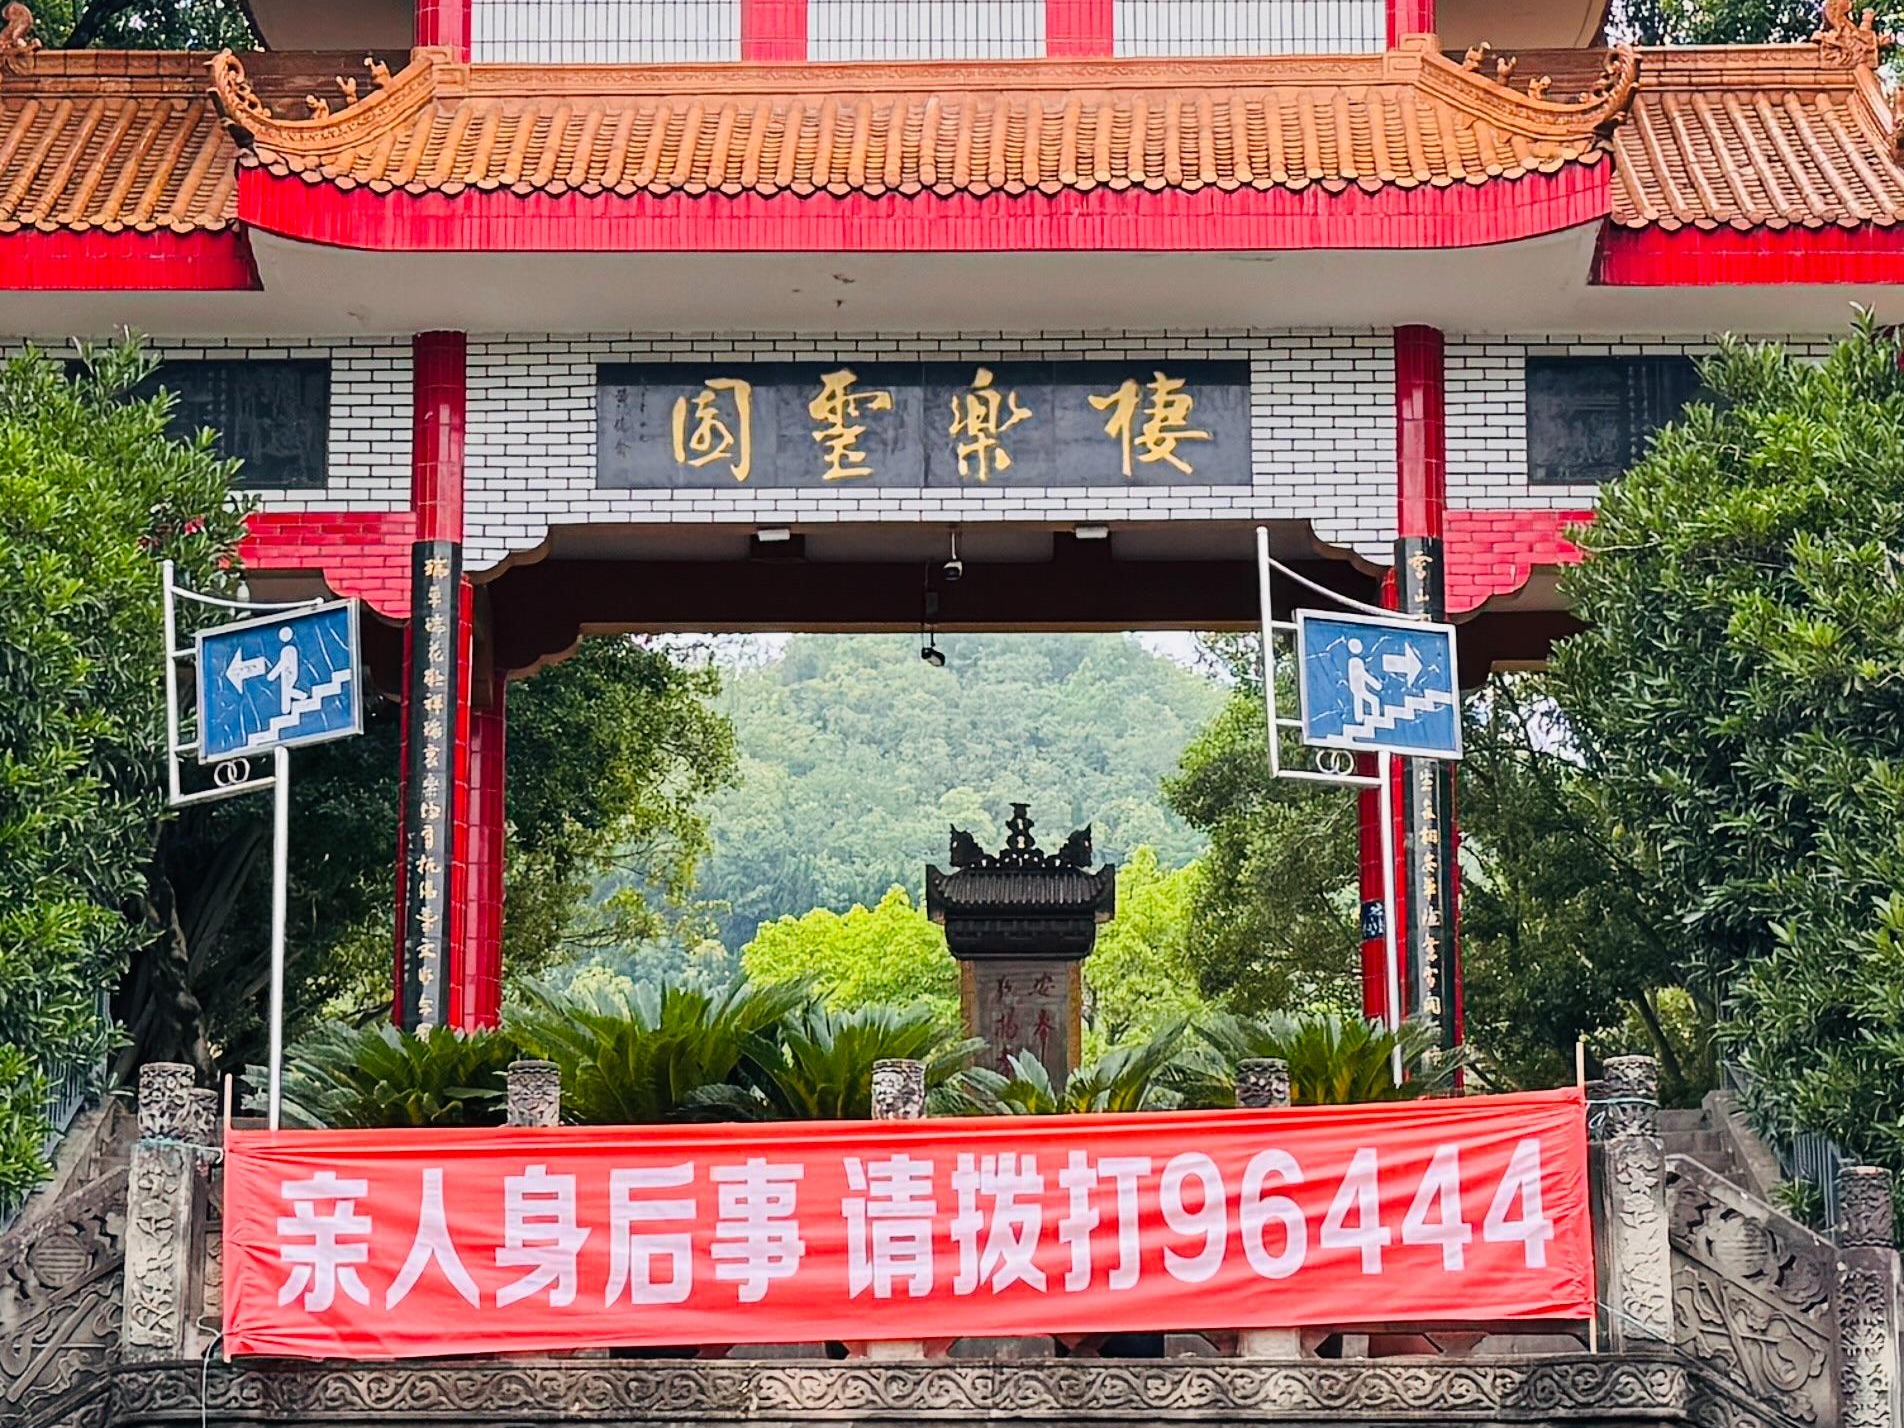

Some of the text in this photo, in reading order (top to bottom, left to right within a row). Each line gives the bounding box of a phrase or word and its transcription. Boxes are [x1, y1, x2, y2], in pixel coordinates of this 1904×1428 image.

[275, 1137, 1551, 1313] 亲人身后事 请拨打96444
